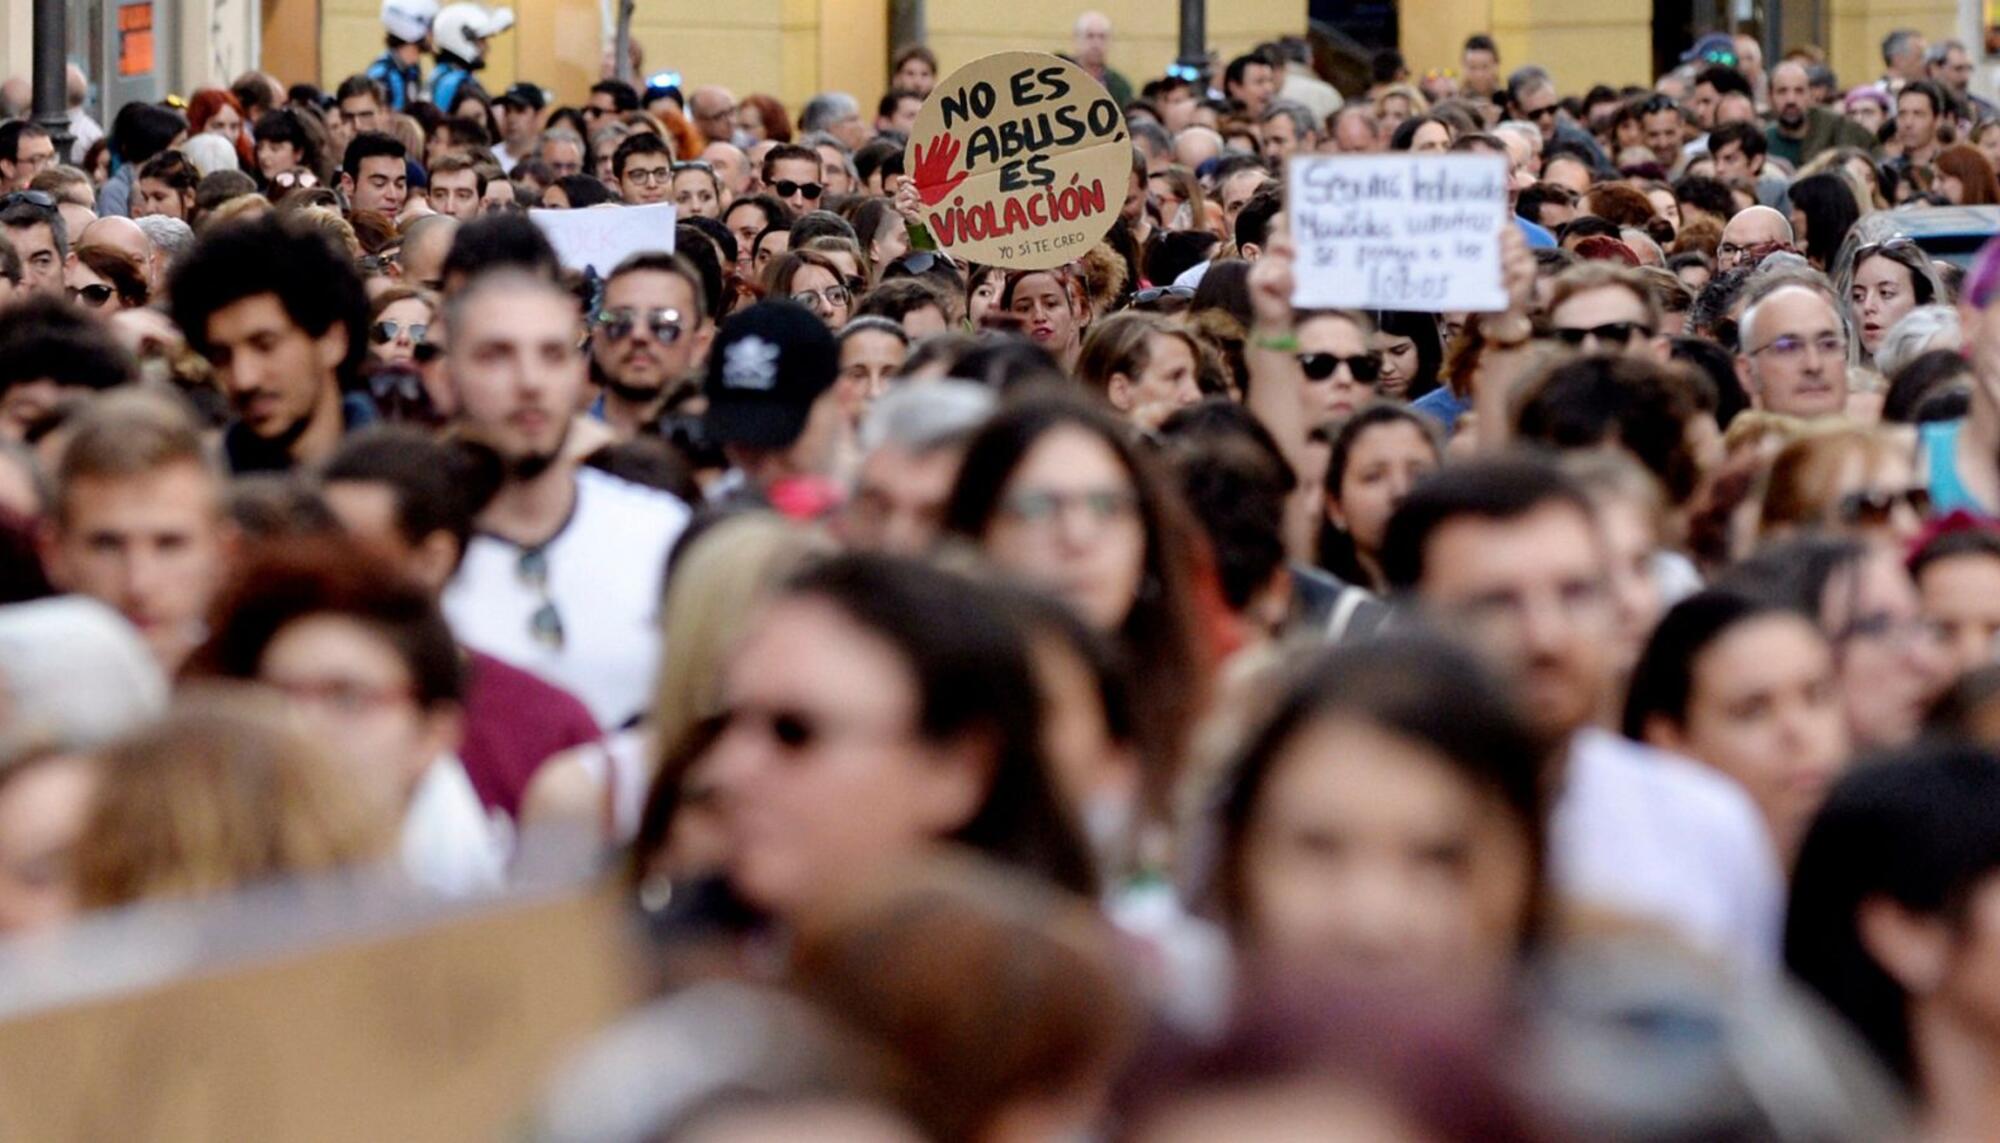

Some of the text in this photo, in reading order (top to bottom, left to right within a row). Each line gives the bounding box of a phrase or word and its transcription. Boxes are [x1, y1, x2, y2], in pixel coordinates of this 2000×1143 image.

[941, 67, 1070, 129] NO ES
[965, 98, 1125, 170] ABUSO,
[999, 154, 1055, 192] ES
[998, 245, 1014, 260] YO
[1034, 240, 1050, 255] TE
[1053, 231, 1086, 249] CREO
